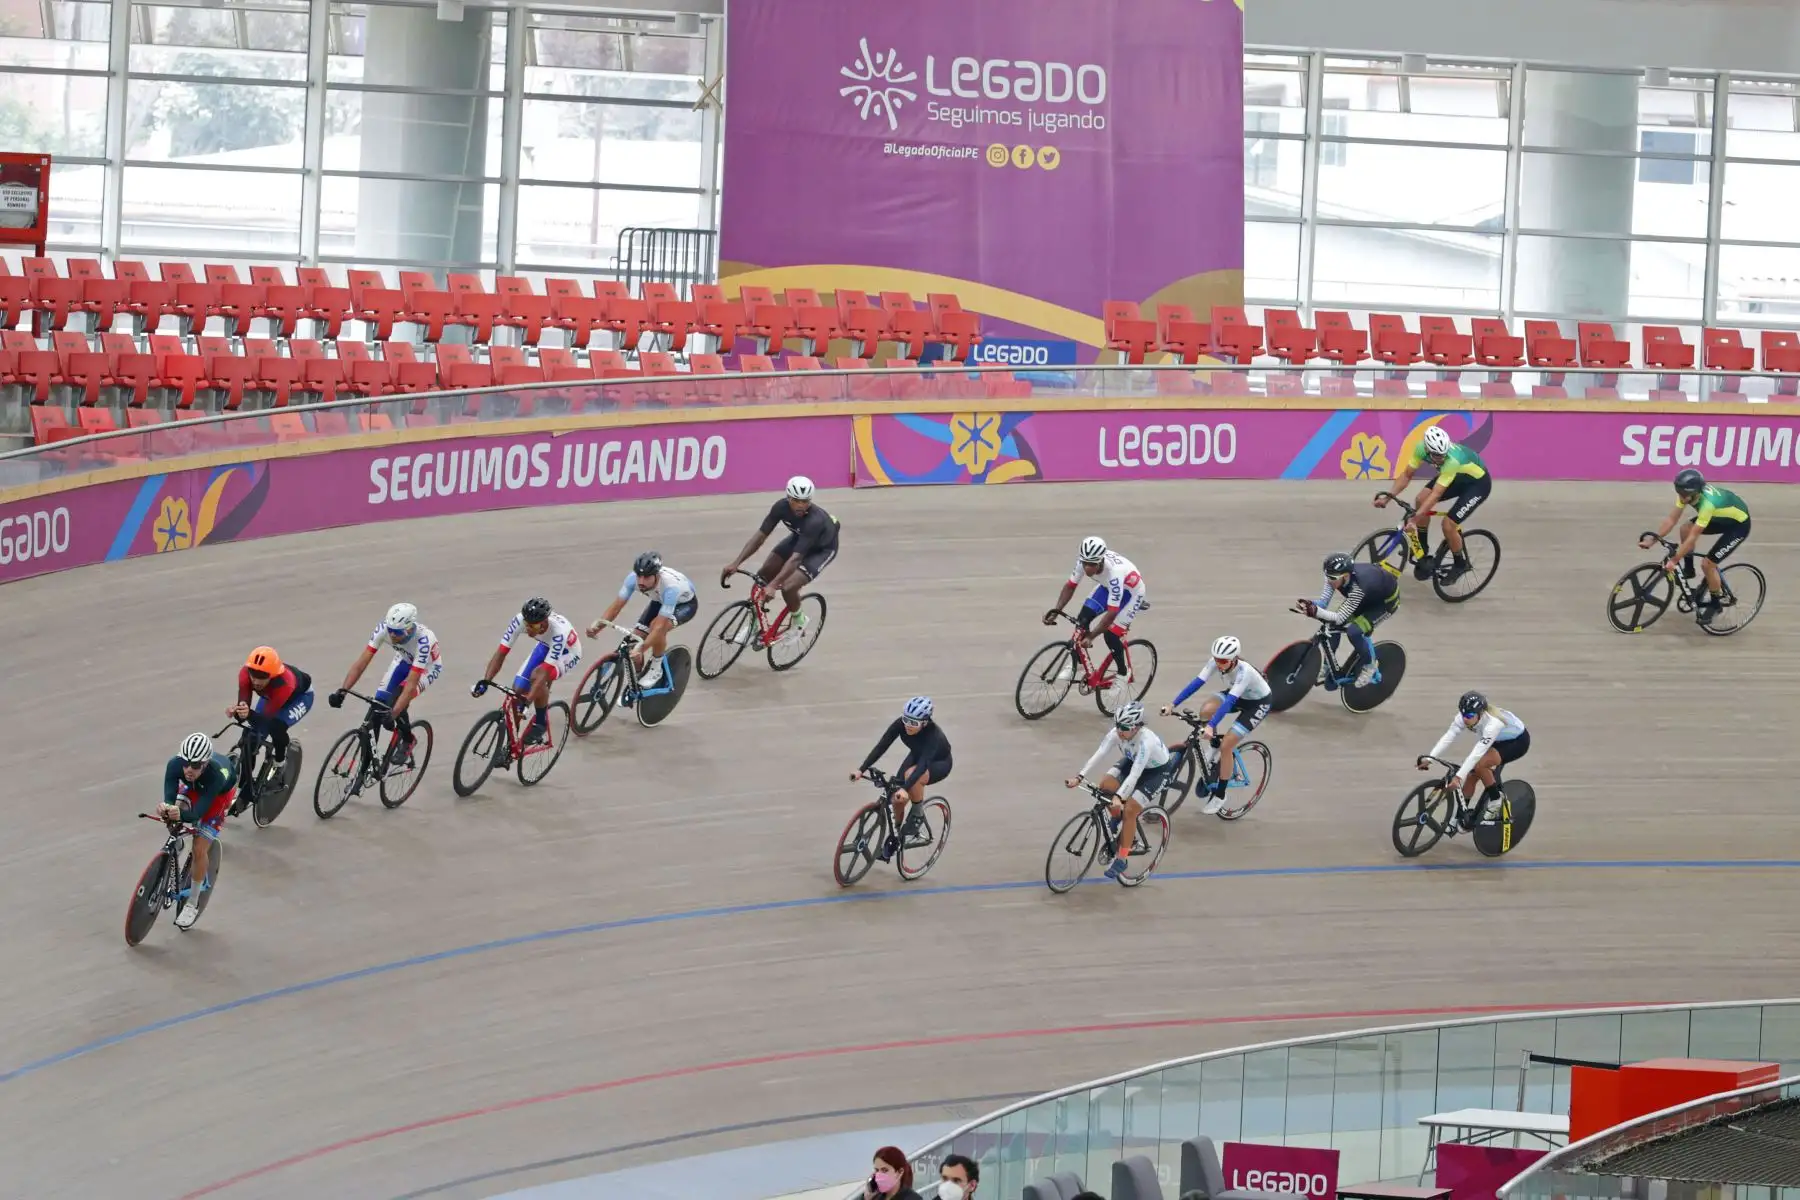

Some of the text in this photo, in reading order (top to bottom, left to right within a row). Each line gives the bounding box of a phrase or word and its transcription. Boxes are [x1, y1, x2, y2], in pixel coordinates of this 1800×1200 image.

[927, 101, 1105, 133] Seguimos jugando
[1620, 424, 1800, 467] SEGUIM
[368, 435, 727, 504] SEGUIMOS JUGANDO
[1714, 538, 1741, 559] BRASIL
[1109, 578, 1121, 602] DOM
[418, 635, 430, 664] DOM
[550, 634, 563, 660] DOM
